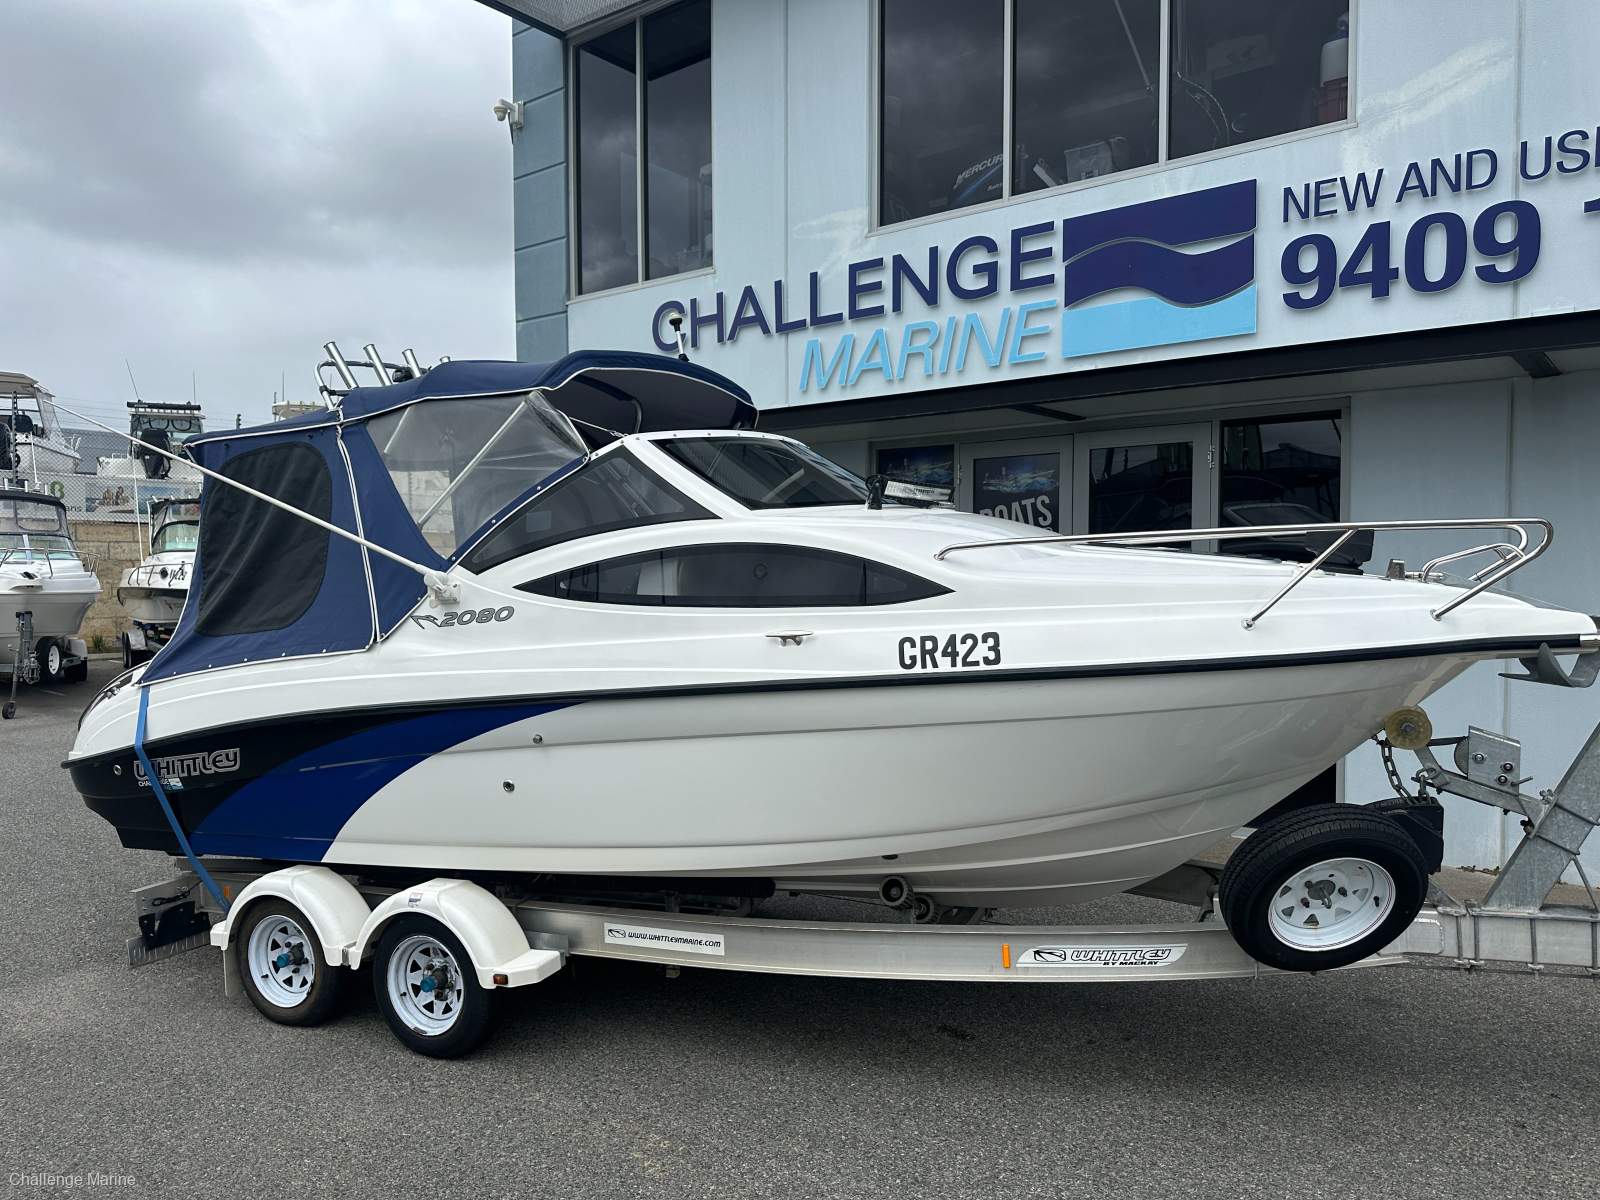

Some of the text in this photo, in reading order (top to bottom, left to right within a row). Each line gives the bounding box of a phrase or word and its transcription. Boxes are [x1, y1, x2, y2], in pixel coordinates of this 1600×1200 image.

[953, 154, 1003, 189] MERCUR
[1283, 127, 1600, 222] NEW AND US
[1280, 200, 1541, 309] 9409
[652, 220, 1056, 352] CHALLENGE
[800, 299, 1058, 392] MARINE
[440, 606, 515, 627] 2080
[898, 631, 1001, 670] GR423
[134, 748, 240, 780] WHITTLEY
[1071, 949, 1171, 962] WHITTLEY
